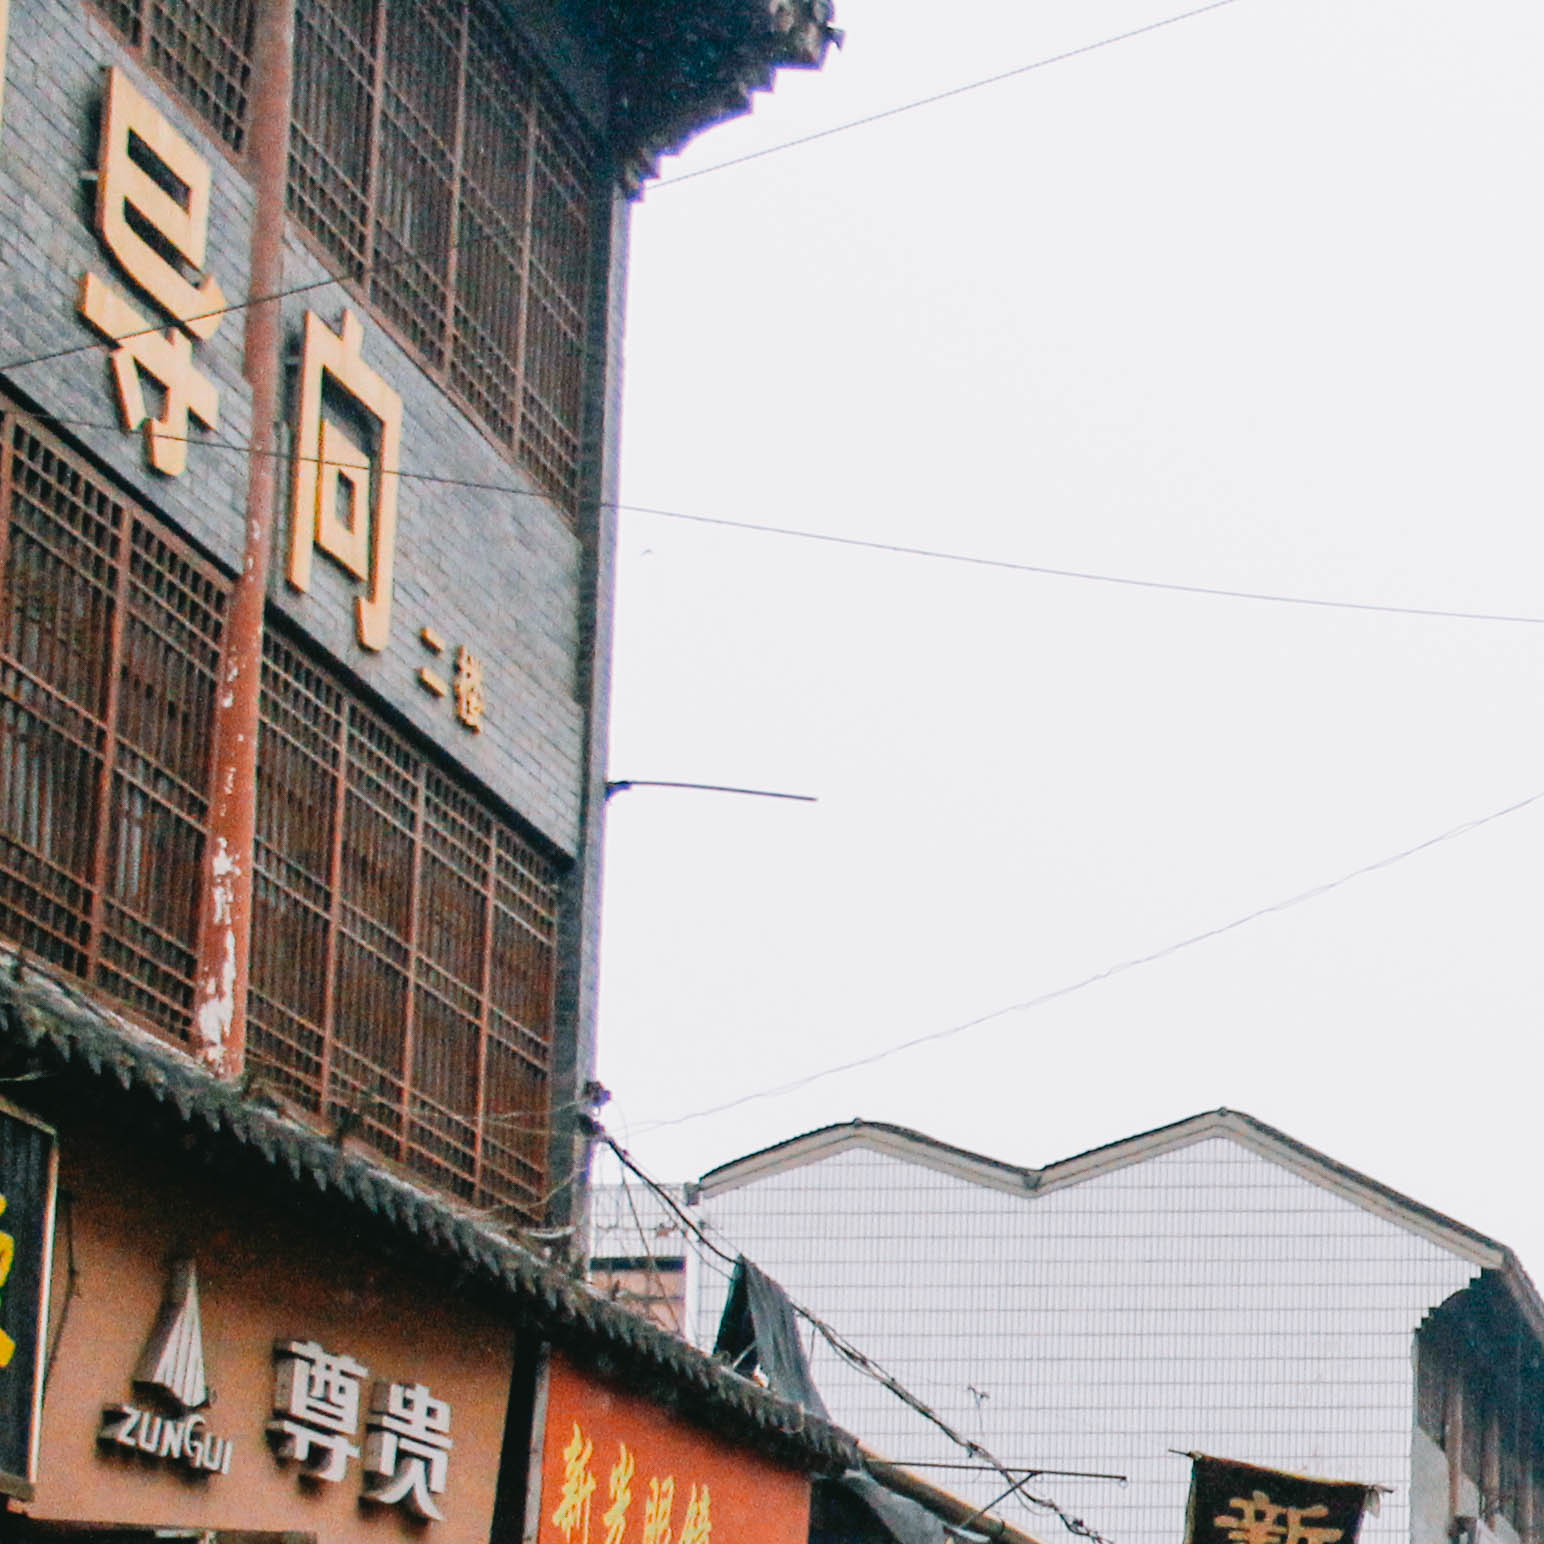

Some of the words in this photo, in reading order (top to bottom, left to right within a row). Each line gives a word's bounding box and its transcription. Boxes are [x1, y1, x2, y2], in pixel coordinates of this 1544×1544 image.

[77, 65, 403, 652] 异向
[119, 1405, 233, 1476] ZUNGUI
[277, 1340, 453, 1522] 尊贵
